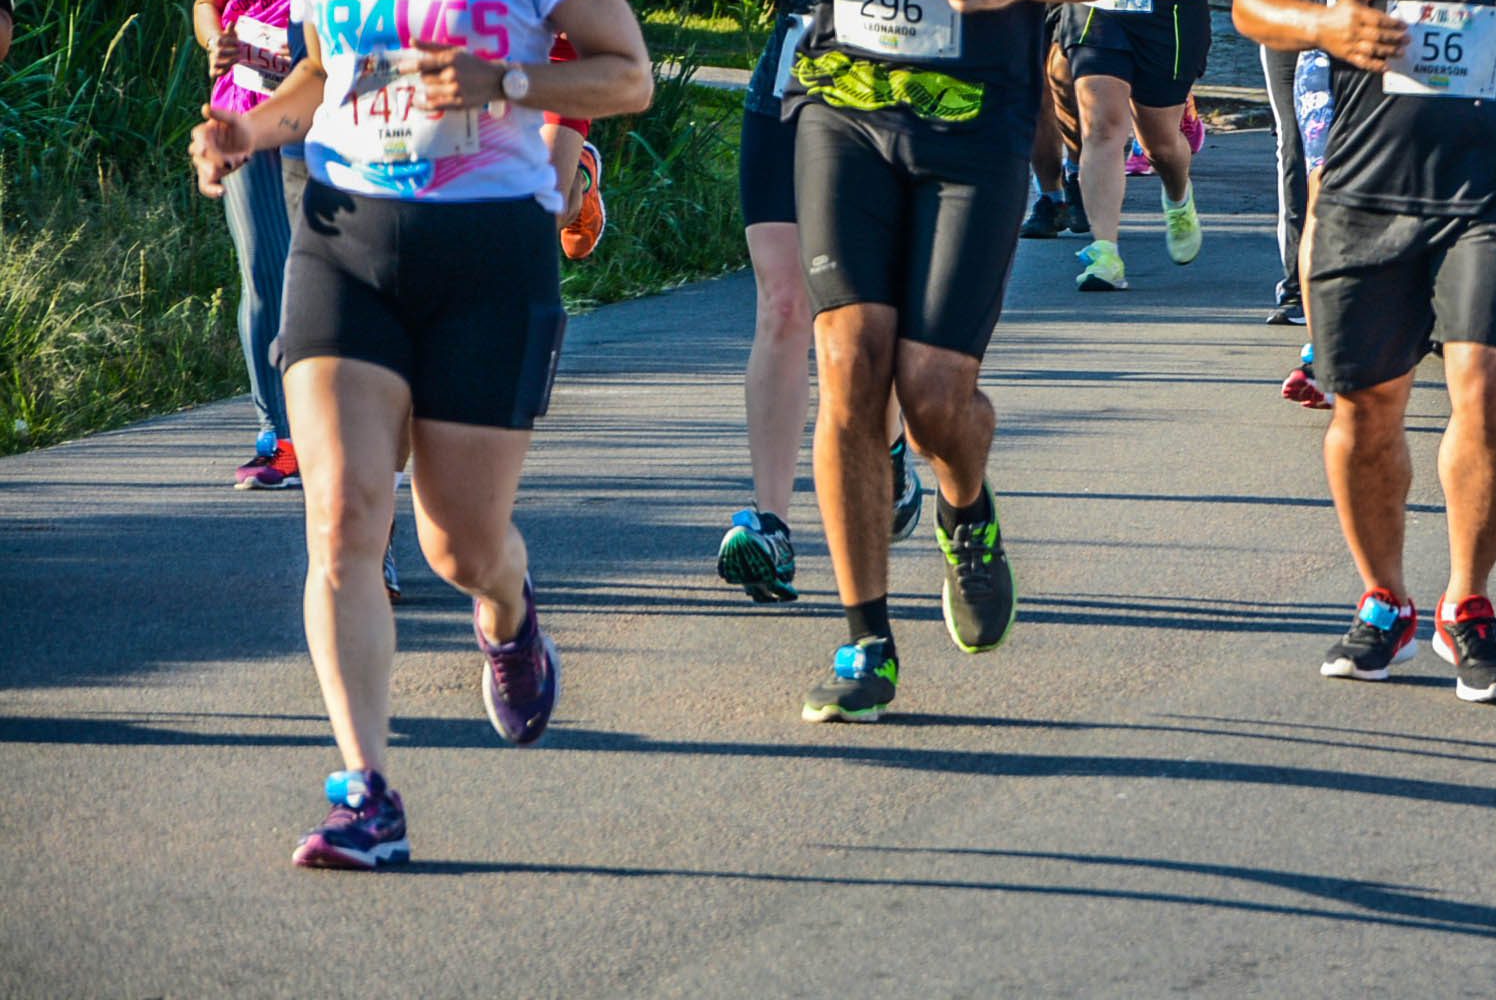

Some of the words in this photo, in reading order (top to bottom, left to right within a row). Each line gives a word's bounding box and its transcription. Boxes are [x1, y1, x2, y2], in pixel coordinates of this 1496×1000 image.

[864, 22, 917, 37] LEONARDO
[1422, 31, 1464, 63] 56
[1413, 64, 1468, 76] ANDERSON
[353, 86, 445, 126] 147
[379, 128, 412, 139] TANIA
